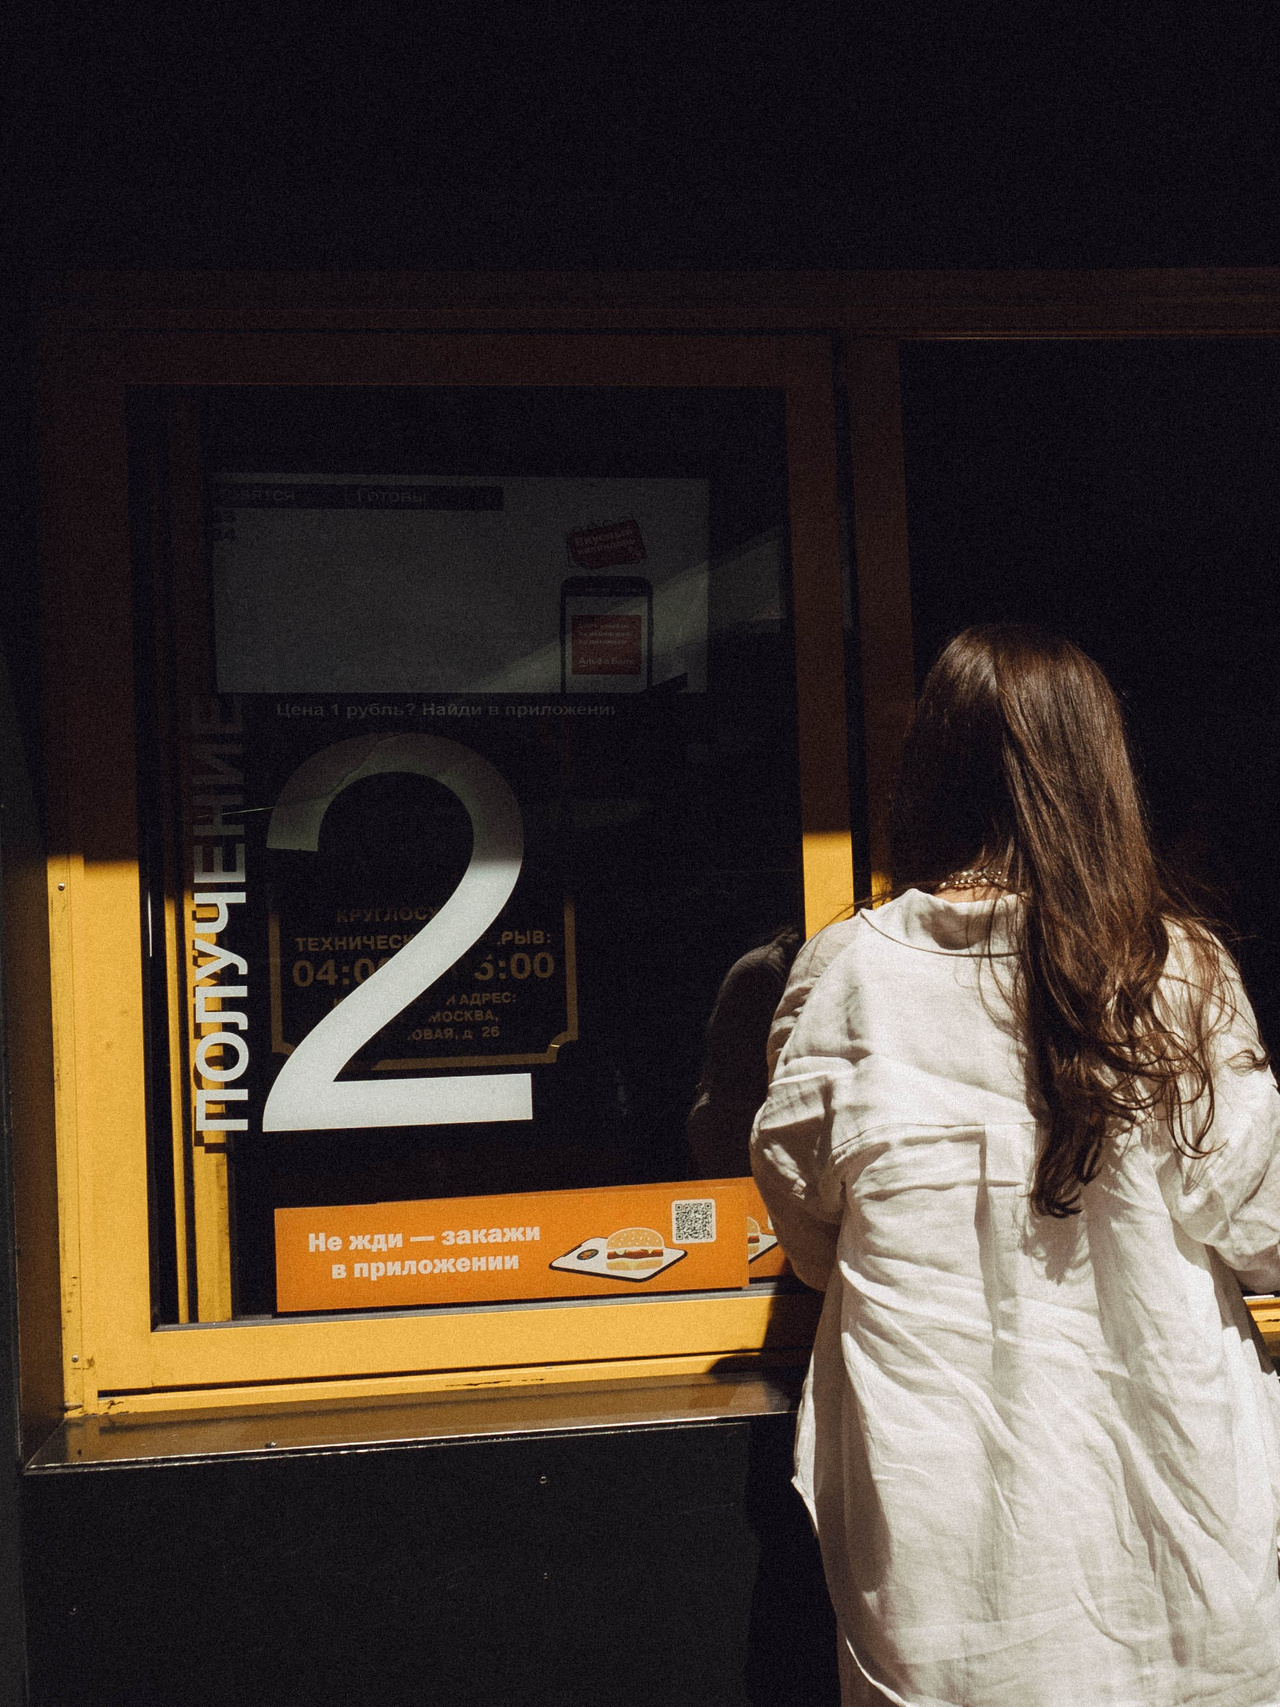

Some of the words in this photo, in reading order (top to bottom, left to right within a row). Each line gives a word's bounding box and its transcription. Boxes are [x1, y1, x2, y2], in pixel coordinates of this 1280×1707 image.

[276, 703, 326, 719] Цена
[330, 703, 340, 717] 1
[423, 702, 482, 719] Найди
[488, 706, 499, 717] в
[193, 696, 249, 1132] ПОЛУЧЕНИЕ
[262, 732, 533, 1132] 2
[497, 930, 552, 946] РЫВ:
[408, 1028, 459, 1042] ОВАЯ,
[481, 1026, 500, 1038] 26
[308, 1231, 342, 1253] Не
[347, 1230, 403, 1255] жди
[441, 1225, 541, 1247] закажи
[331, 1263, 347, 1280] в
[353, 1253, 519, 1280] приложении
